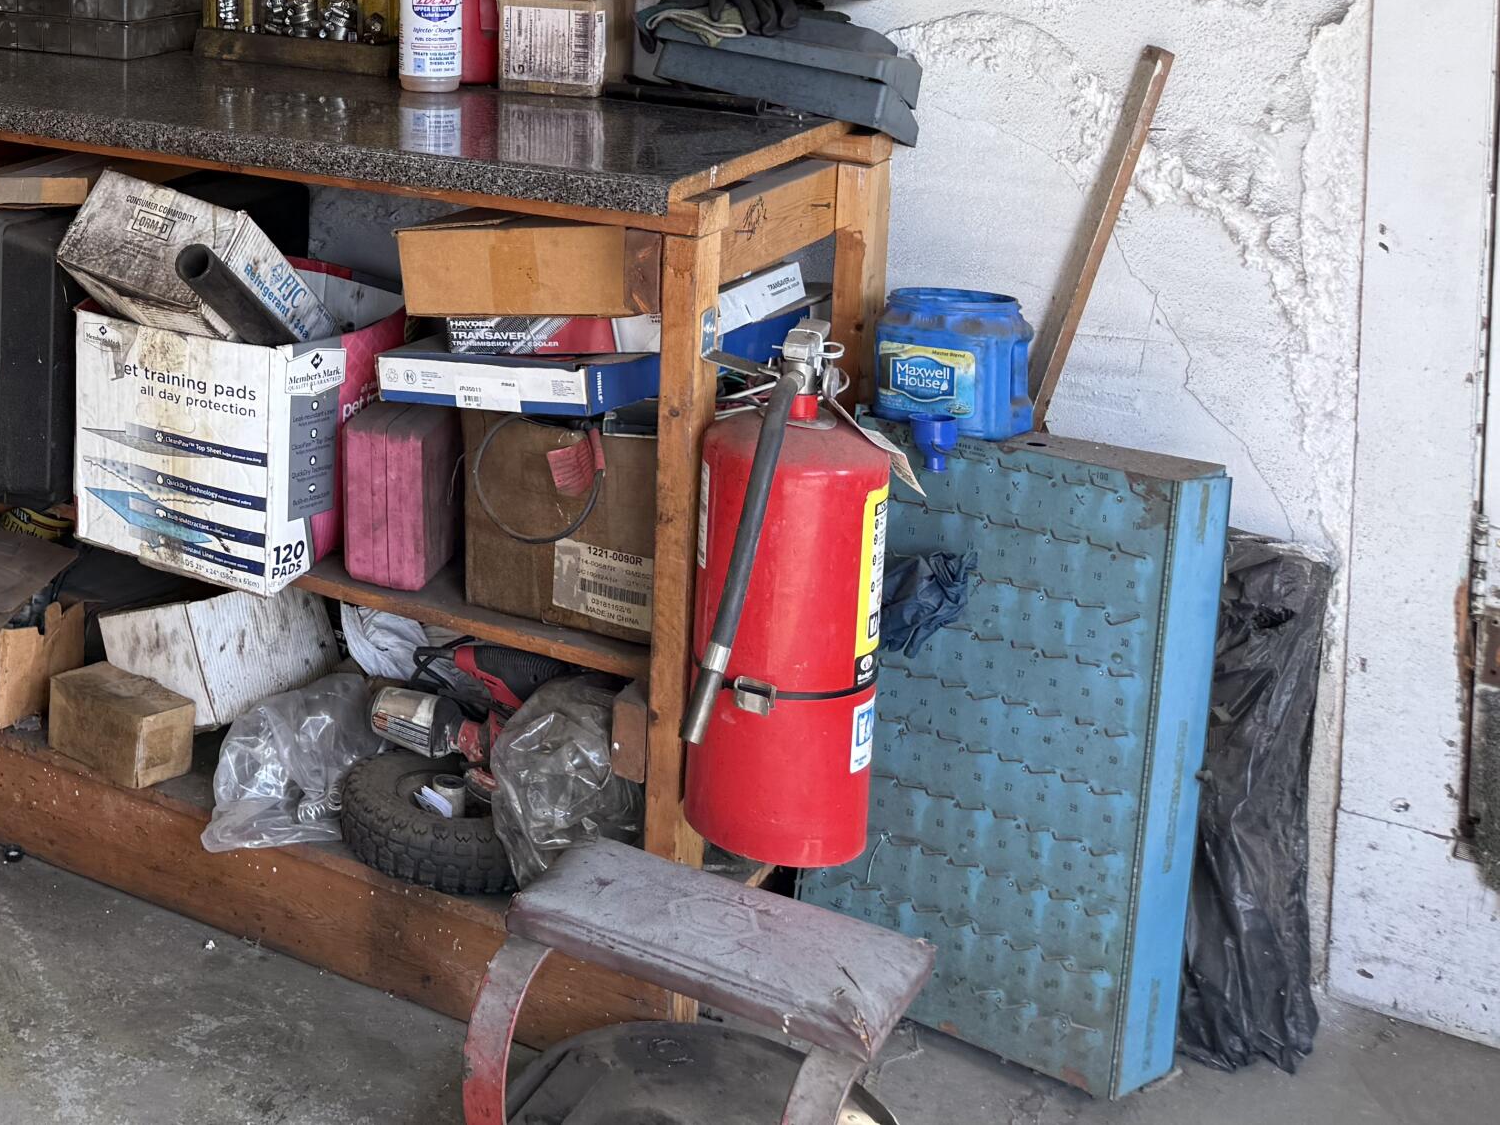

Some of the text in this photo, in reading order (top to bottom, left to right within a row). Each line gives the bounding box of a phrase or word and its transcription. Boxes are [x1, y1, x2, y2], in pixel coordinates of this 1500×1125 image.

[126, 195, 198, 224] CONSUMER COMMODITY
[138, 216, 168, 234] ORM-D
[243, 262, 310, 340] Refrigerant 134a
[277, 273, 308, 309] FJC
[450, 320, 497, 331] HAYDEN
[450, 331, 525, 341] TRANSAVER
[451, 340, 560, 348] TRANSMISSION OIL COOLER
[289, 370, 323, 388] Member's
[895, 361, 950, 381] Maxwell
[122, 364, 258, 402] et training pads
[896, 374, 942, 390] House
[140, 385, 257, 418] all day protection
[341, 396, 364, 424] pet
[195, 443, 206, 454] Top
[206, 446, 223, 456] Sheet
[188, 486, 218, 500] Technology
[273, 539, 305, 566] 120
[587, 545, 644, 567] 1221-0090R
[271, 559, 302, 580] PADS
[585, 605, 640, 626] MADE IN CHINA
